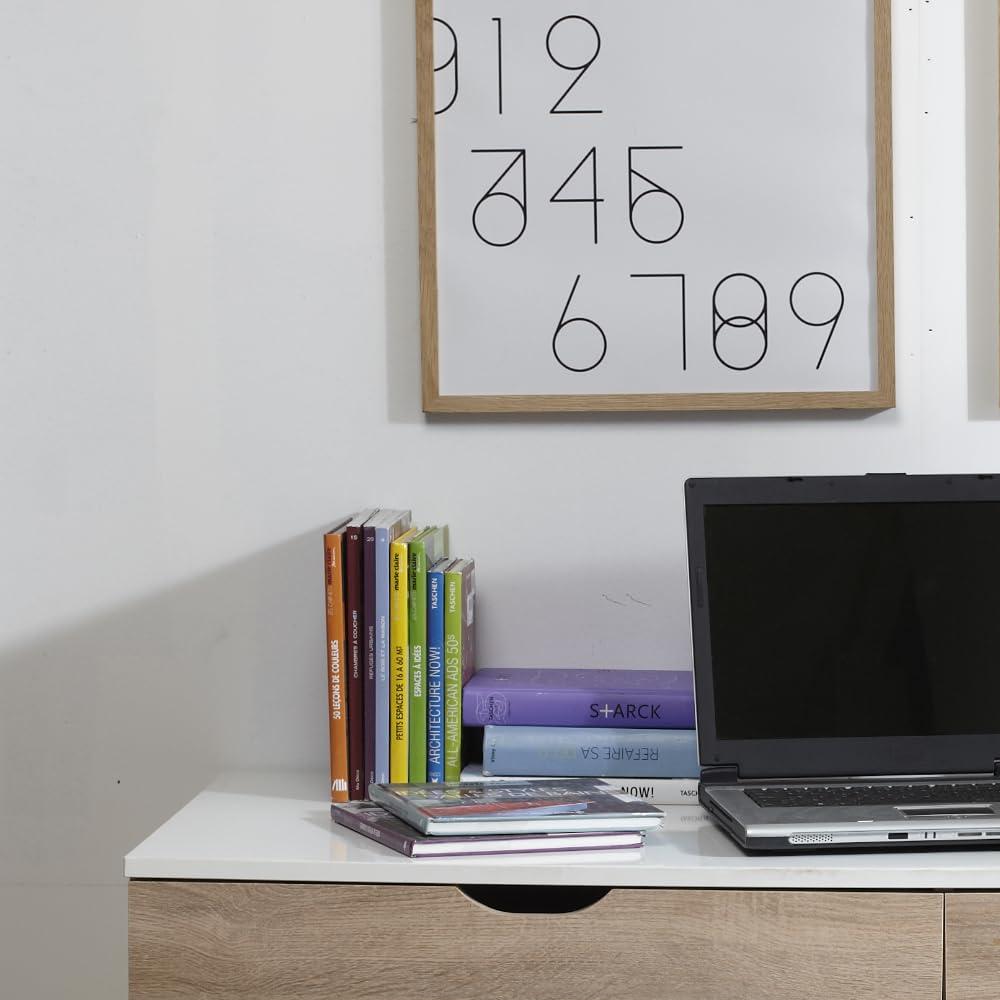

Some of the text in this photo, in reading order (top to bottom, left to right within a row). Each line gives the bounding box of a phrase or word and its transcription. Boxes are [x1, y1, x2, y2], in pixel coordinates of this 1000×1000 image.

[396, 656, 403, 665] 60
[412, 645, 422, 662] IDÉES
[429, 647, 440, 677] NOW!
[396, 673, 403, 681] 16
[447, 658, 458, 681] ADS
[330, 640, 342, 720] 50 LEÇONS DE COULEURS
[396, 683, 403, 692] DE
[414, 671, 422, 697] ESPACES
[429, 681, 440, 764] ARCHITECTURE
[447, 684, 458, 767] ALL-AMERICAN
[581, 746, 600, 760] SA
[602, 746, 659, 761] REFAIRE
